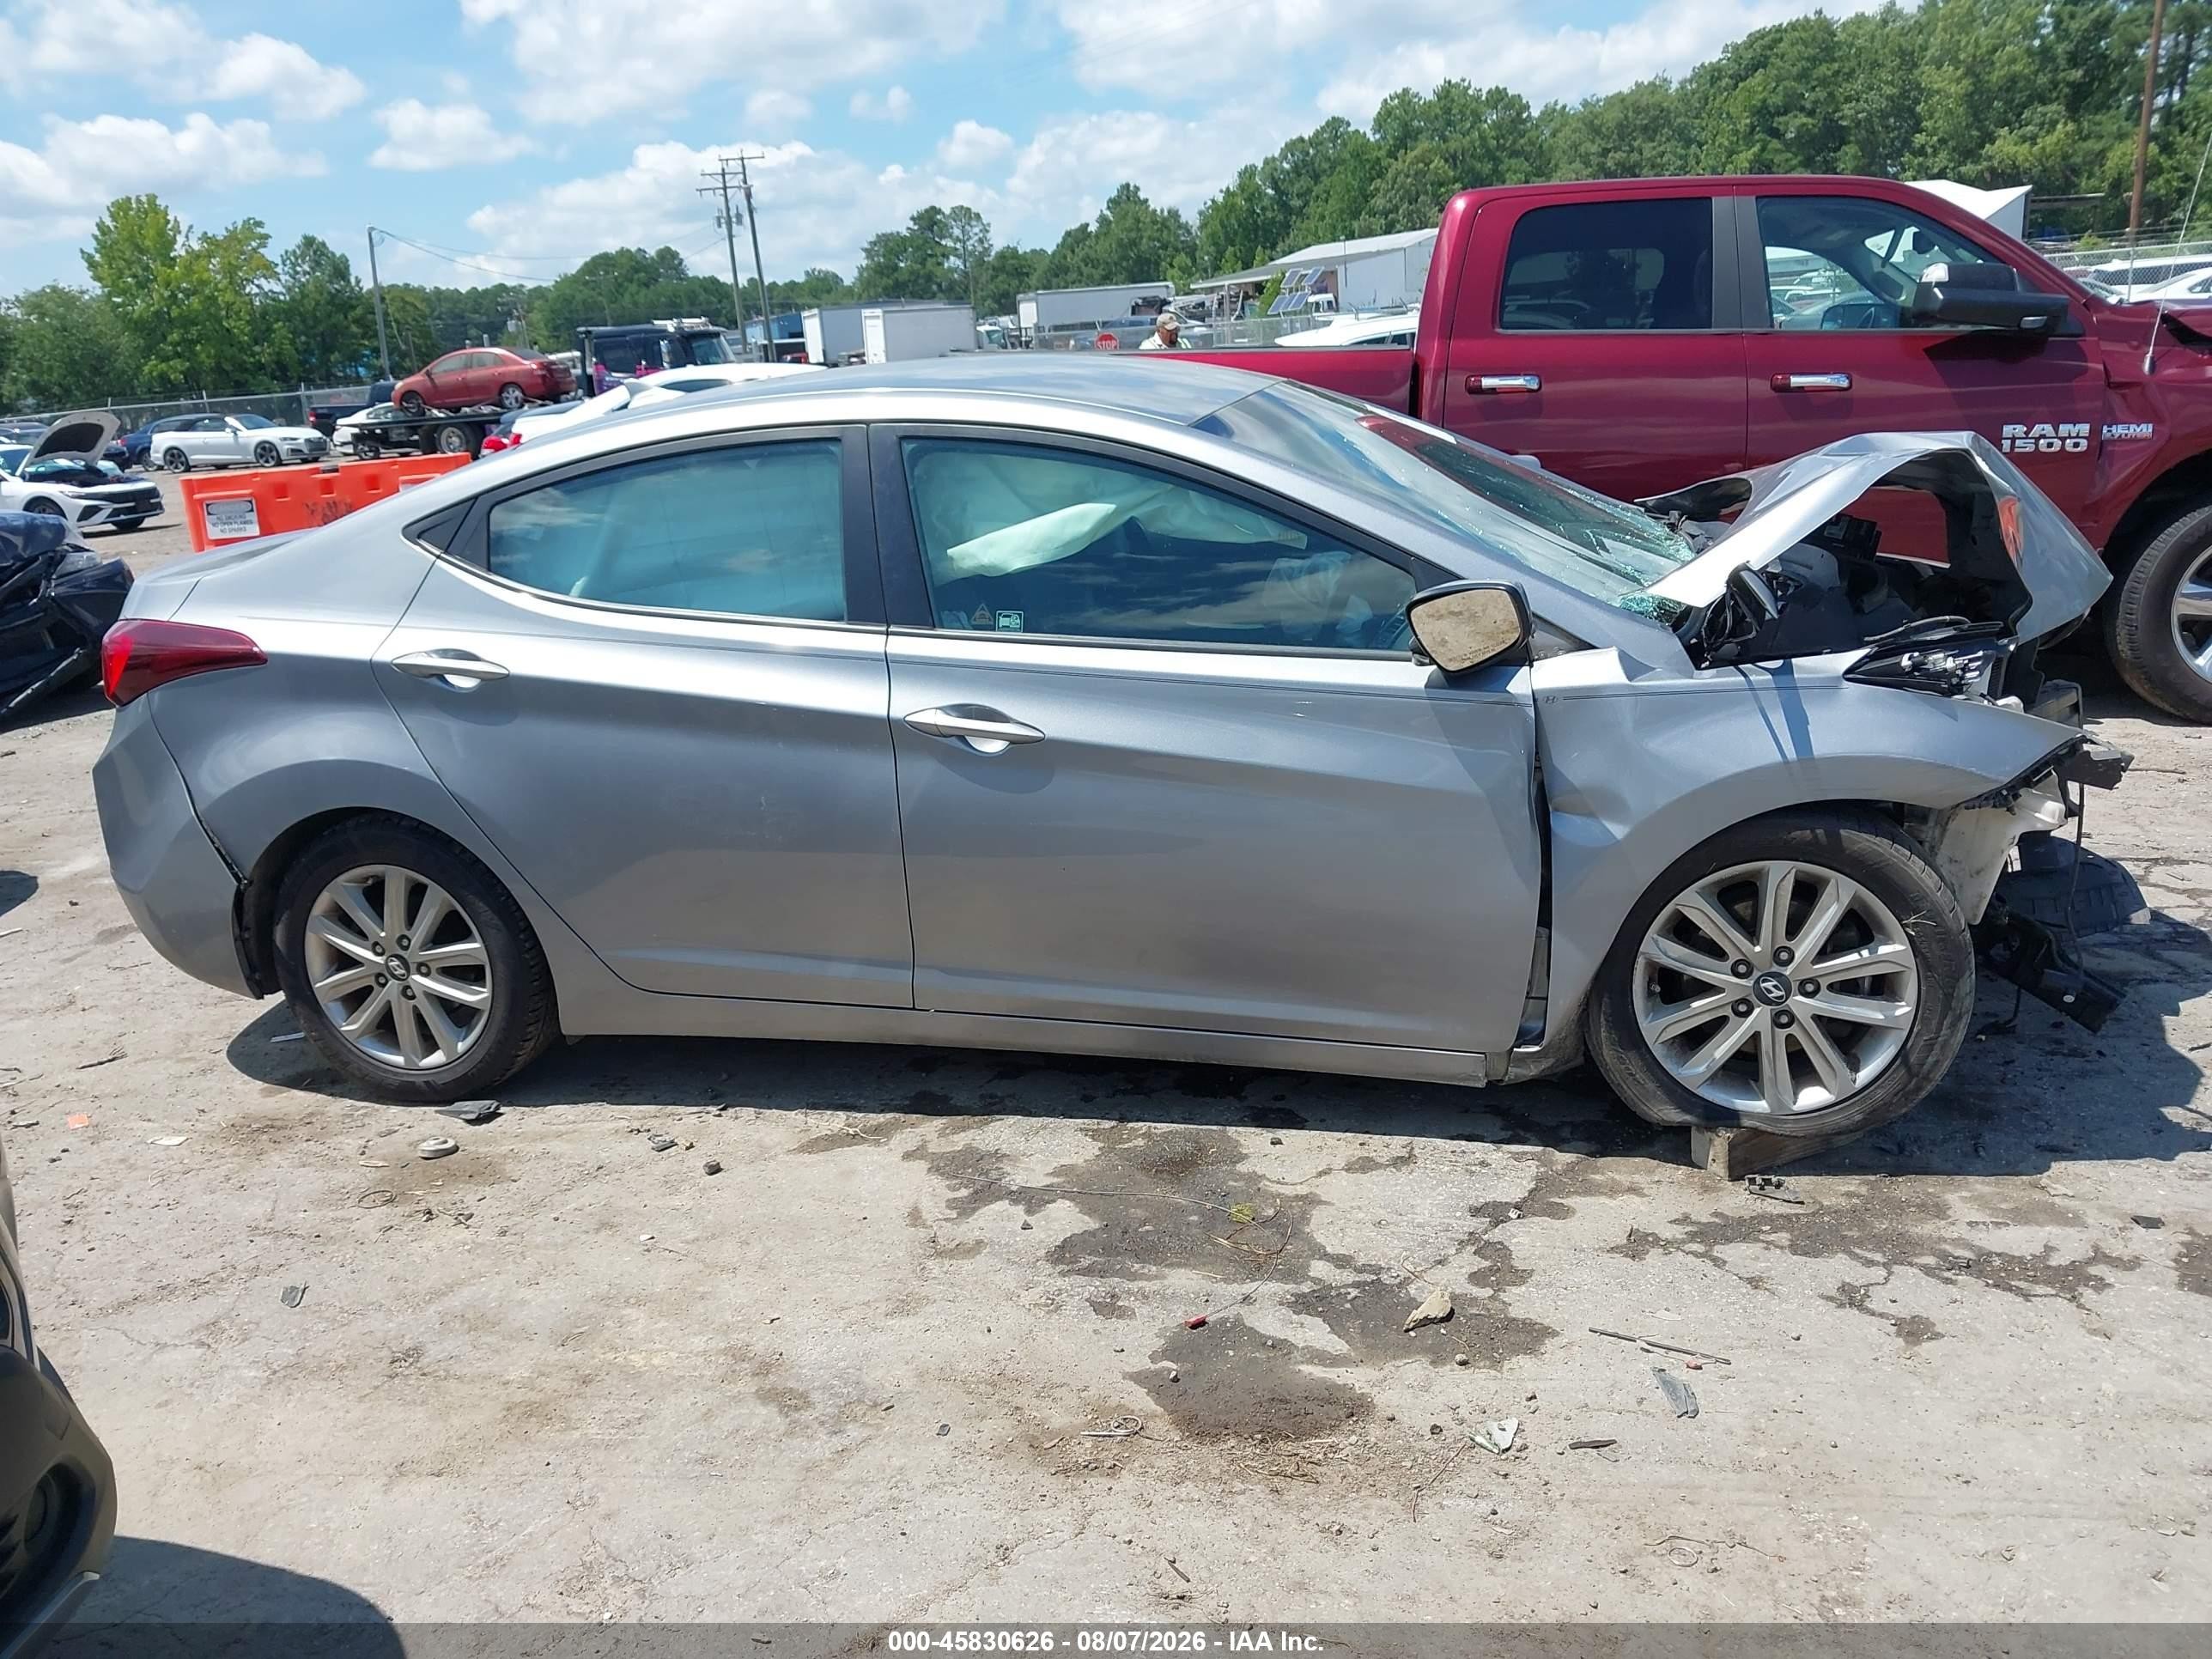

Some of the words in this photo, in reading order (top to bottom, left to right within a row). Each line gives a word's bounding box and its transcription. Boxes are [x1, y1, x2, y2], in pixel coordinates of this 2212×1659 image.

[1097, 340, 1117, 351] STOP
[2002, 422, 2091, 438] RAM
[2101, 422, 2154, 434] HEMI
[2001, 438, 2088, 453] 1500
